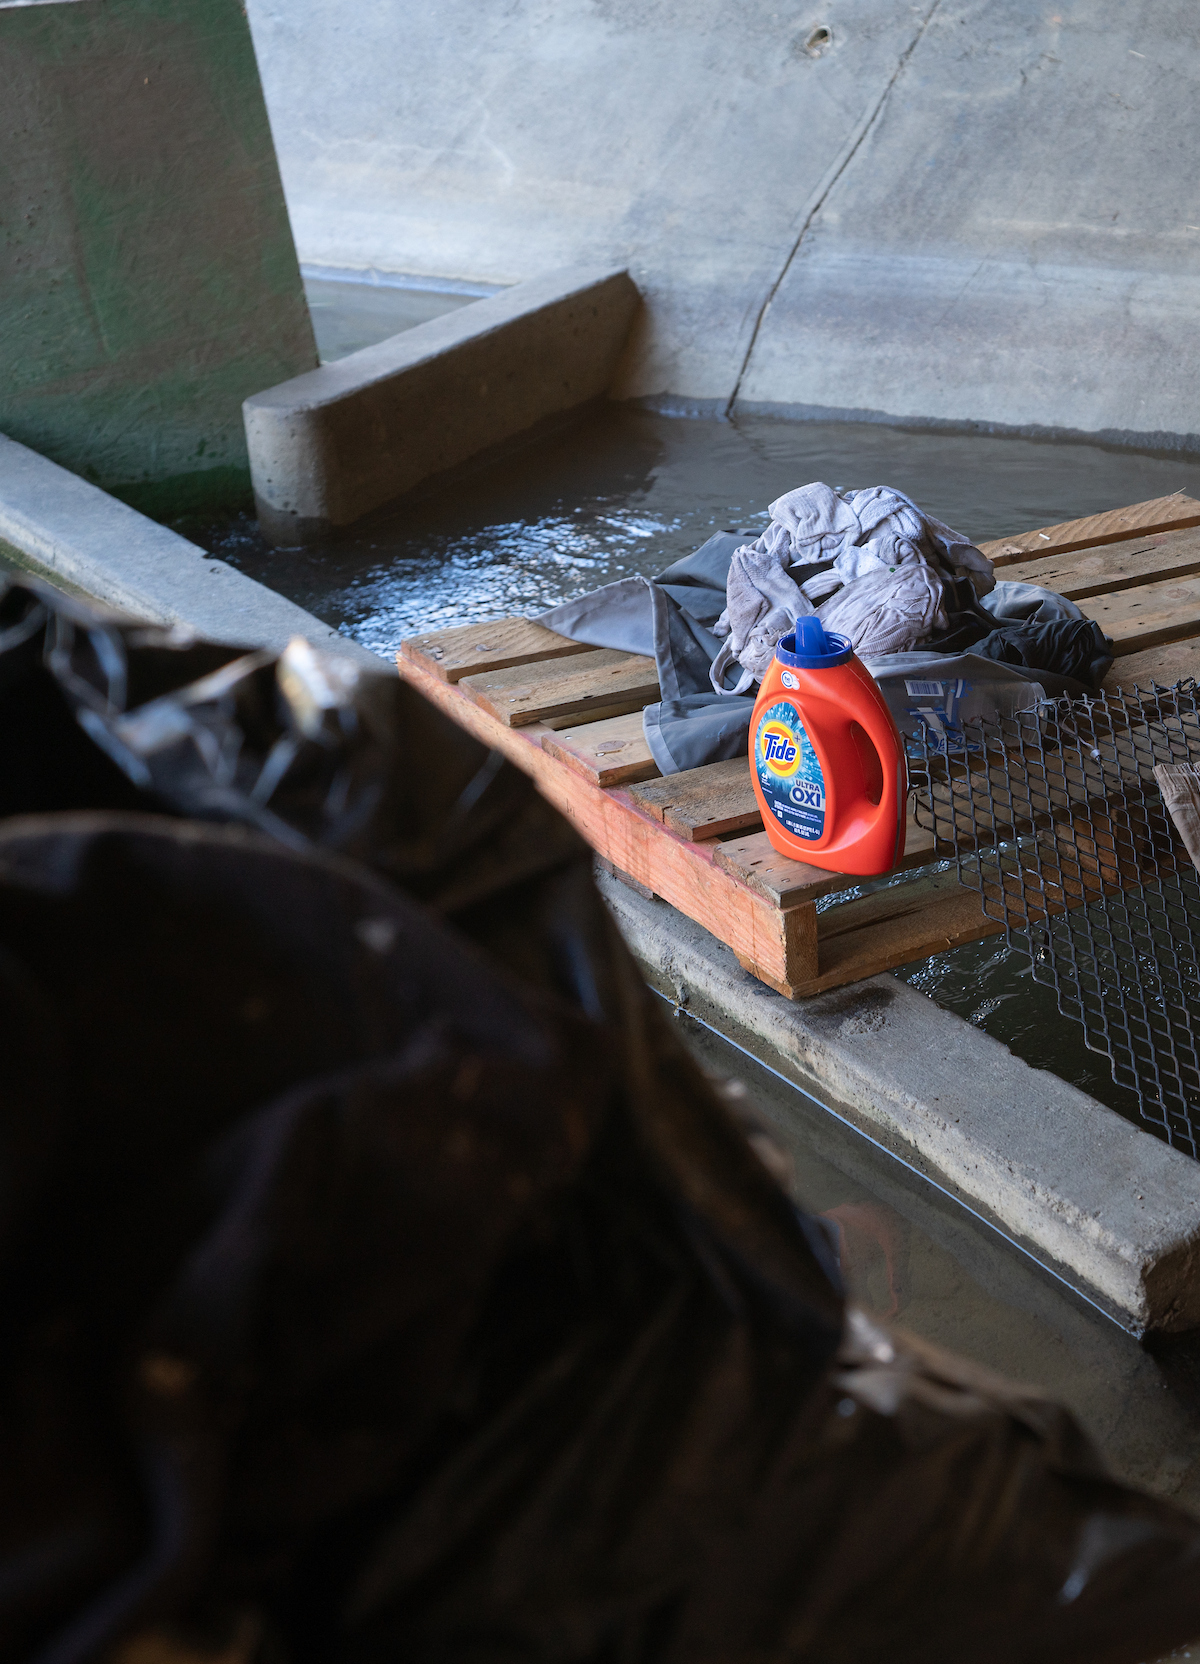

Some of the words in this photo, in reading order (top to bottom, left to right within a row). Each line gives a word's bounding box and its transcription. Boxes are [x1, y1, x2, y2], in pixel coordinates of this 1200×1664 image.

[764, 733, 796, 762] Tide
[795, 779, 821, 792] ULTRA
[792, 787, 821, 808] OXI
